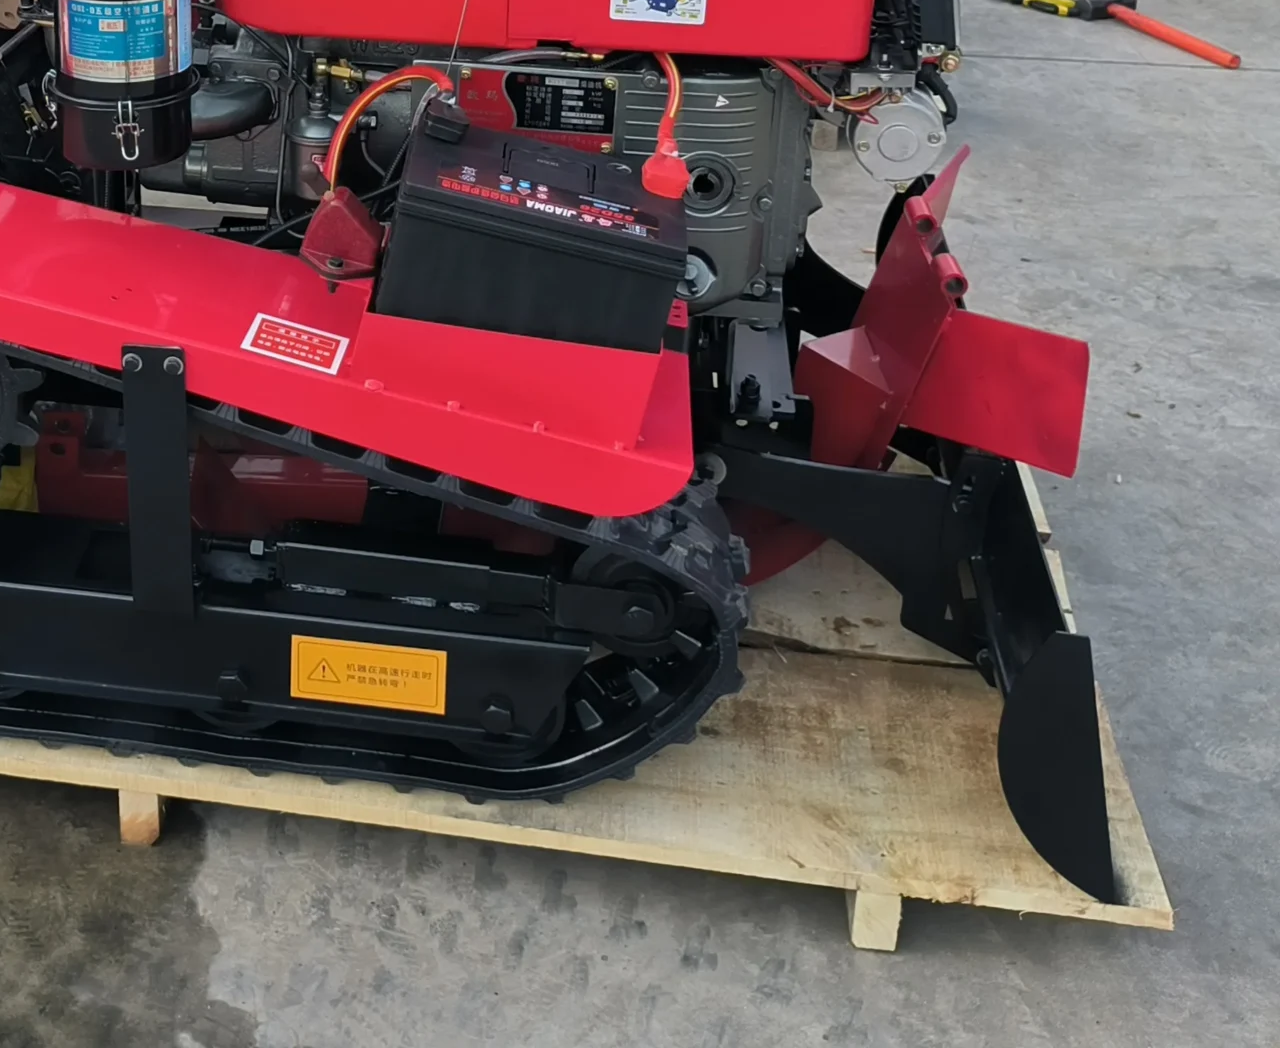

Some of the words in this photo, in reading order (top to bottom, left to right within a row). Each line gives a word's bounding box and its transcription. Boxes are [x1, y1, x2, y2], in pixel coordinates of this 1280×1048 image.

[525, 198, 578, 219] JIAOMA
[346, 663, 433, 680] 机器在高速行走时
